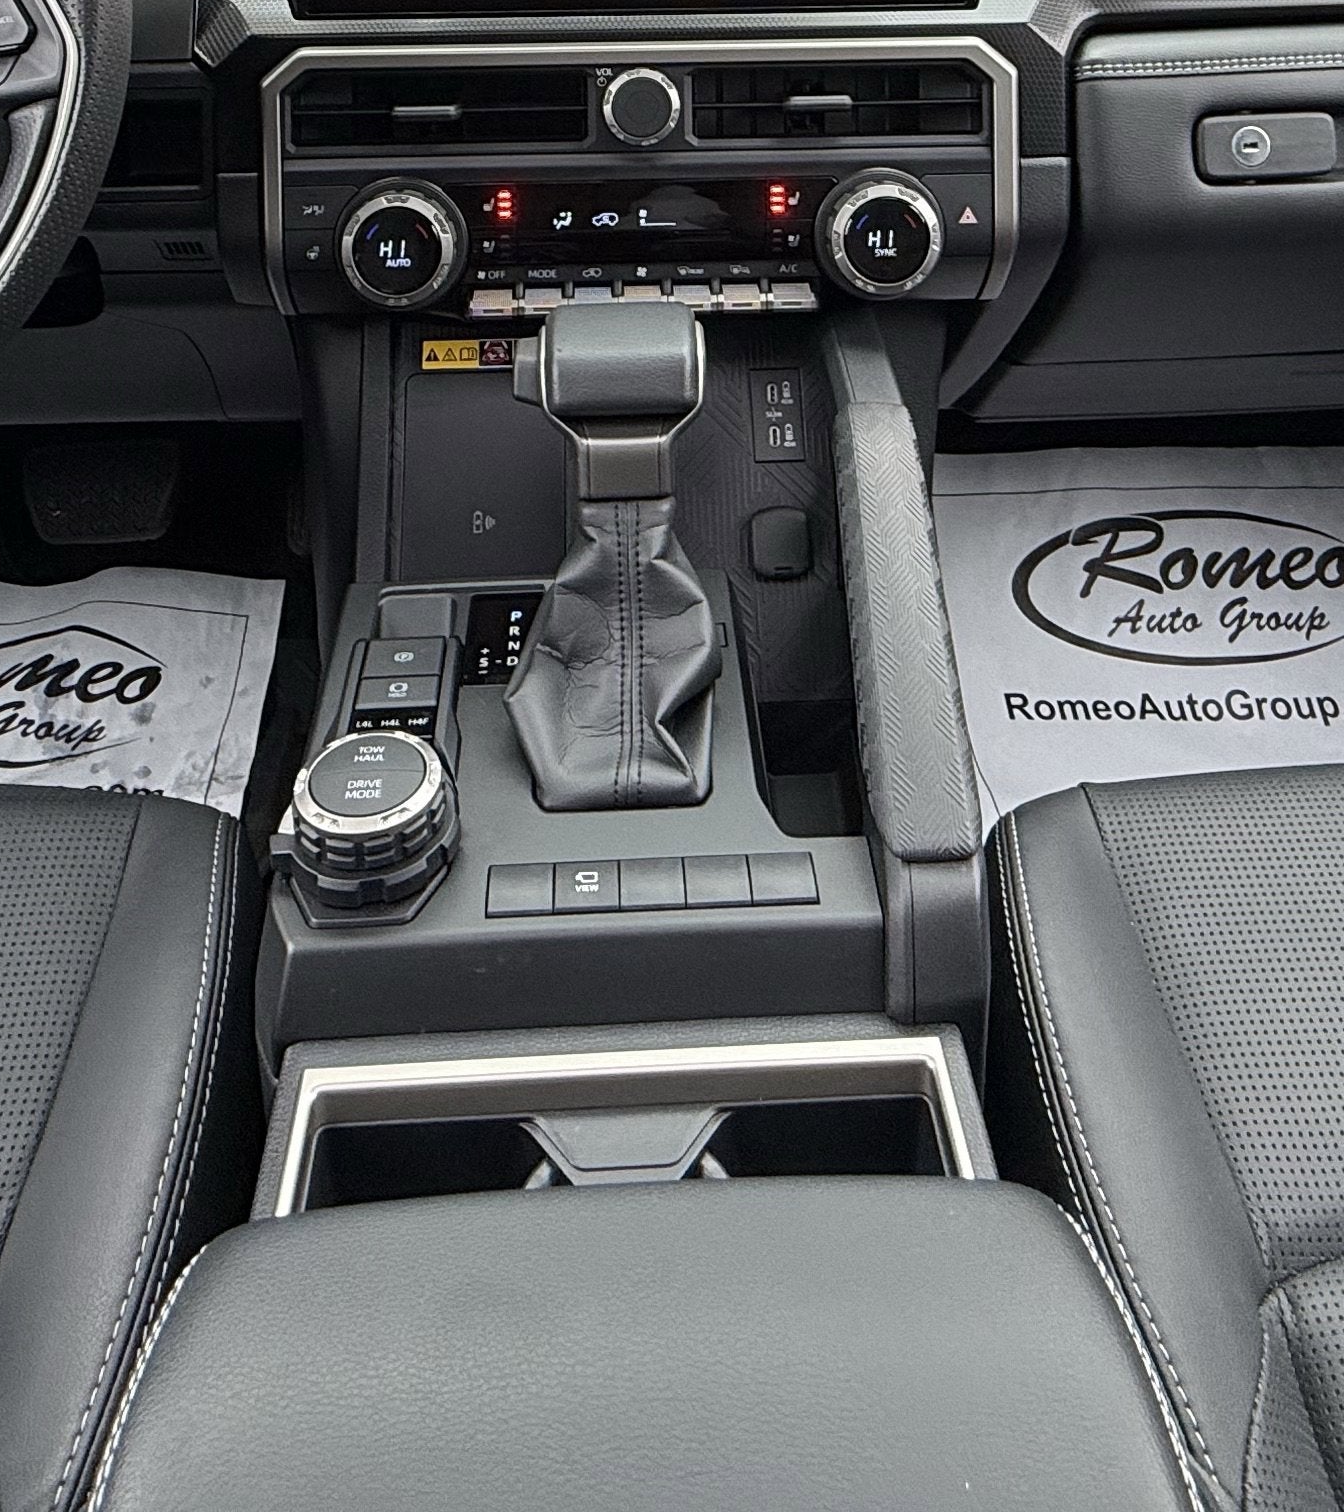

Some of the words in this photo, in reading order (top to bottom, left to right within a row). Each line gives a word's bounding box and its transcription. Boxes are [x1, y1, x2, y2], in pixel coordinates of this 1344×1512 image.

[594, 67, 614, 77] VOL
[868, 230, 896, 249] HI
[380, 240, 407, 260] HI
[874, 247, 898, 258] SYNC
[384, 258, 412, 268] AUTO
[779, 263, 799, 274] A/C
[488, 269, 507, 281] OFF
[527, 269, 557, 280] MODE
[510, 610, 523, 623] P
[1106, 598, 1202, 638] Auto
[1218, 596, 1333, 644] Group
[509, 625, 520, 637] R
[507, 640, 520, 652] N
[478, 656, 490, 669] S
[506, 655, 519, 667] D
[380, 718, 401, 727] H4L
[358, 744, 386, 754] TOW
[353, 753, 385, 763] HAUL
[346, 779, 384, 789] DRIVE
[344, 788, 383, 800] MODE
[574, 883, 599, 893] VIEW
